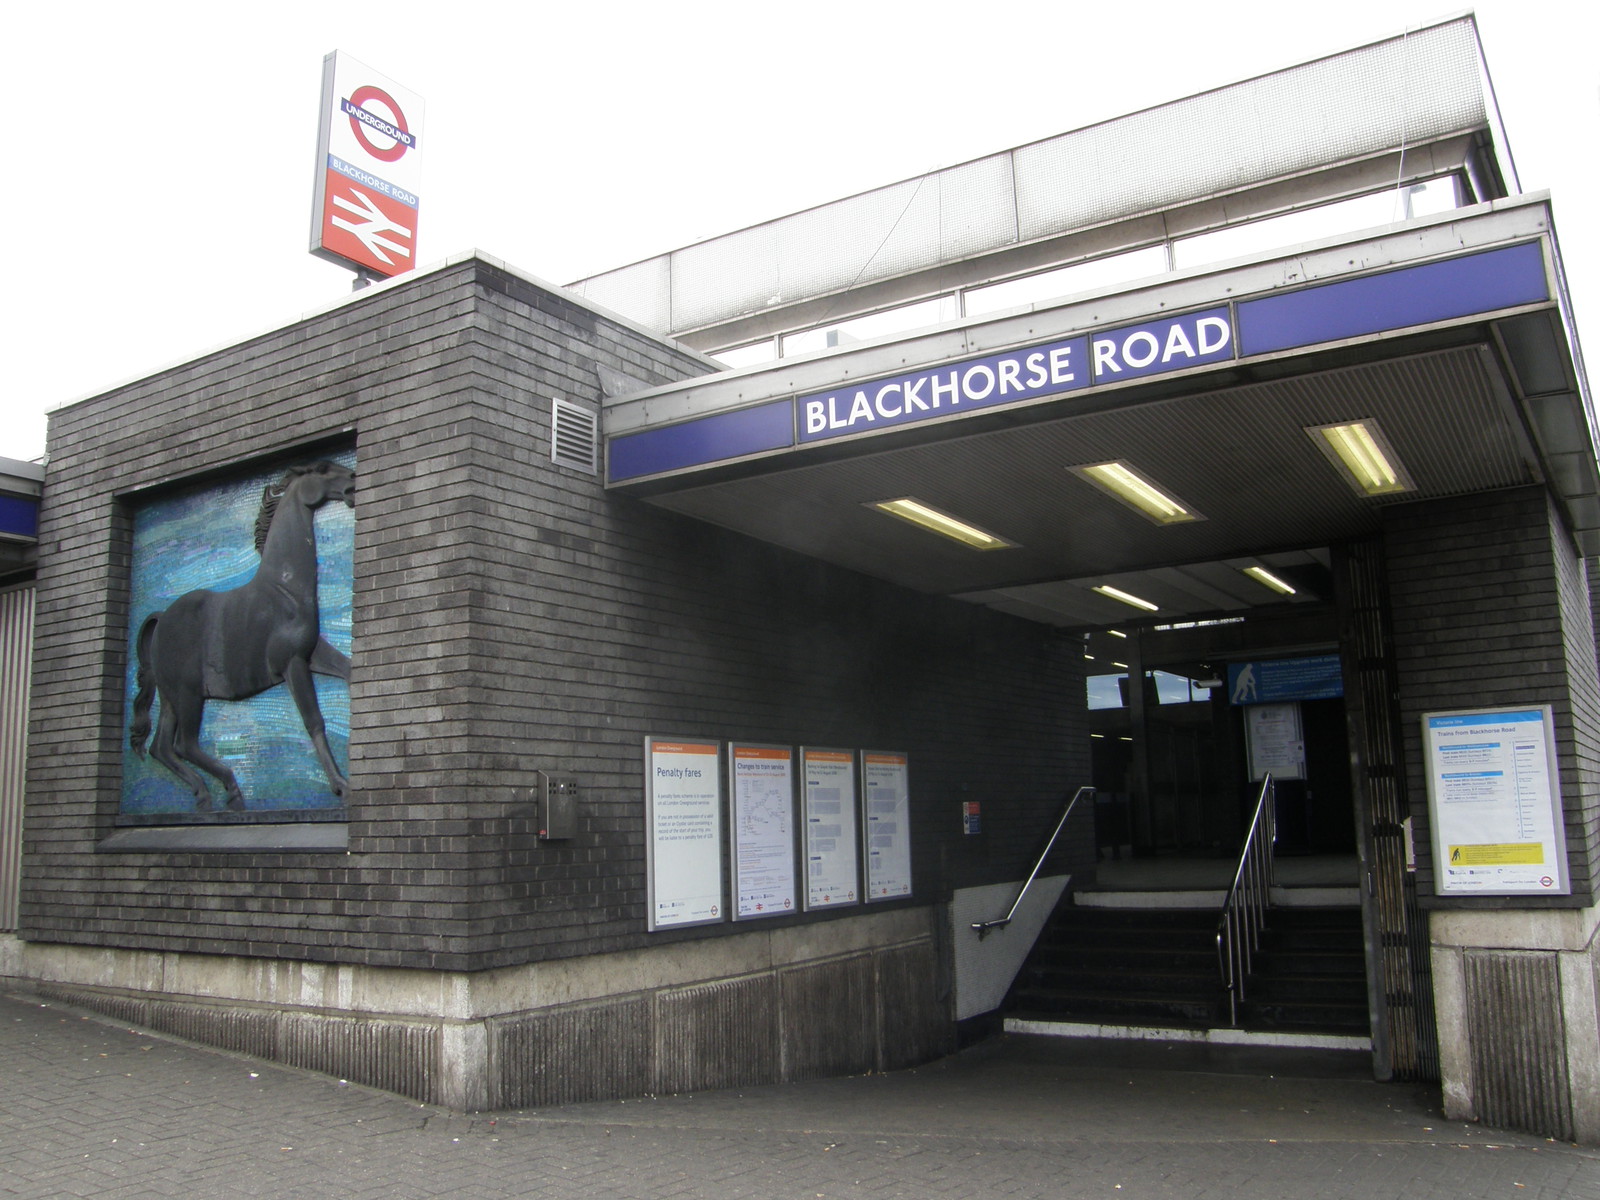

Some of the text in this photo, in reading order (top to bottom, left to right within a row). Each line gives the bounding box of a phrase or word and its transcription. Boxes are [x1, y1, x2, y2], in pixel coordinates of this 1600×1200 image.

[345, 103, 411, 144] UNDERGROUND
[333, 158, 416, 205] BLACKHORSE ROAD
[806, 316, 1231, 434] BLACKHORSE ROAD
[657, 767, 702, 779] Penalty fares
[737, 762, 755, 771] Changes
